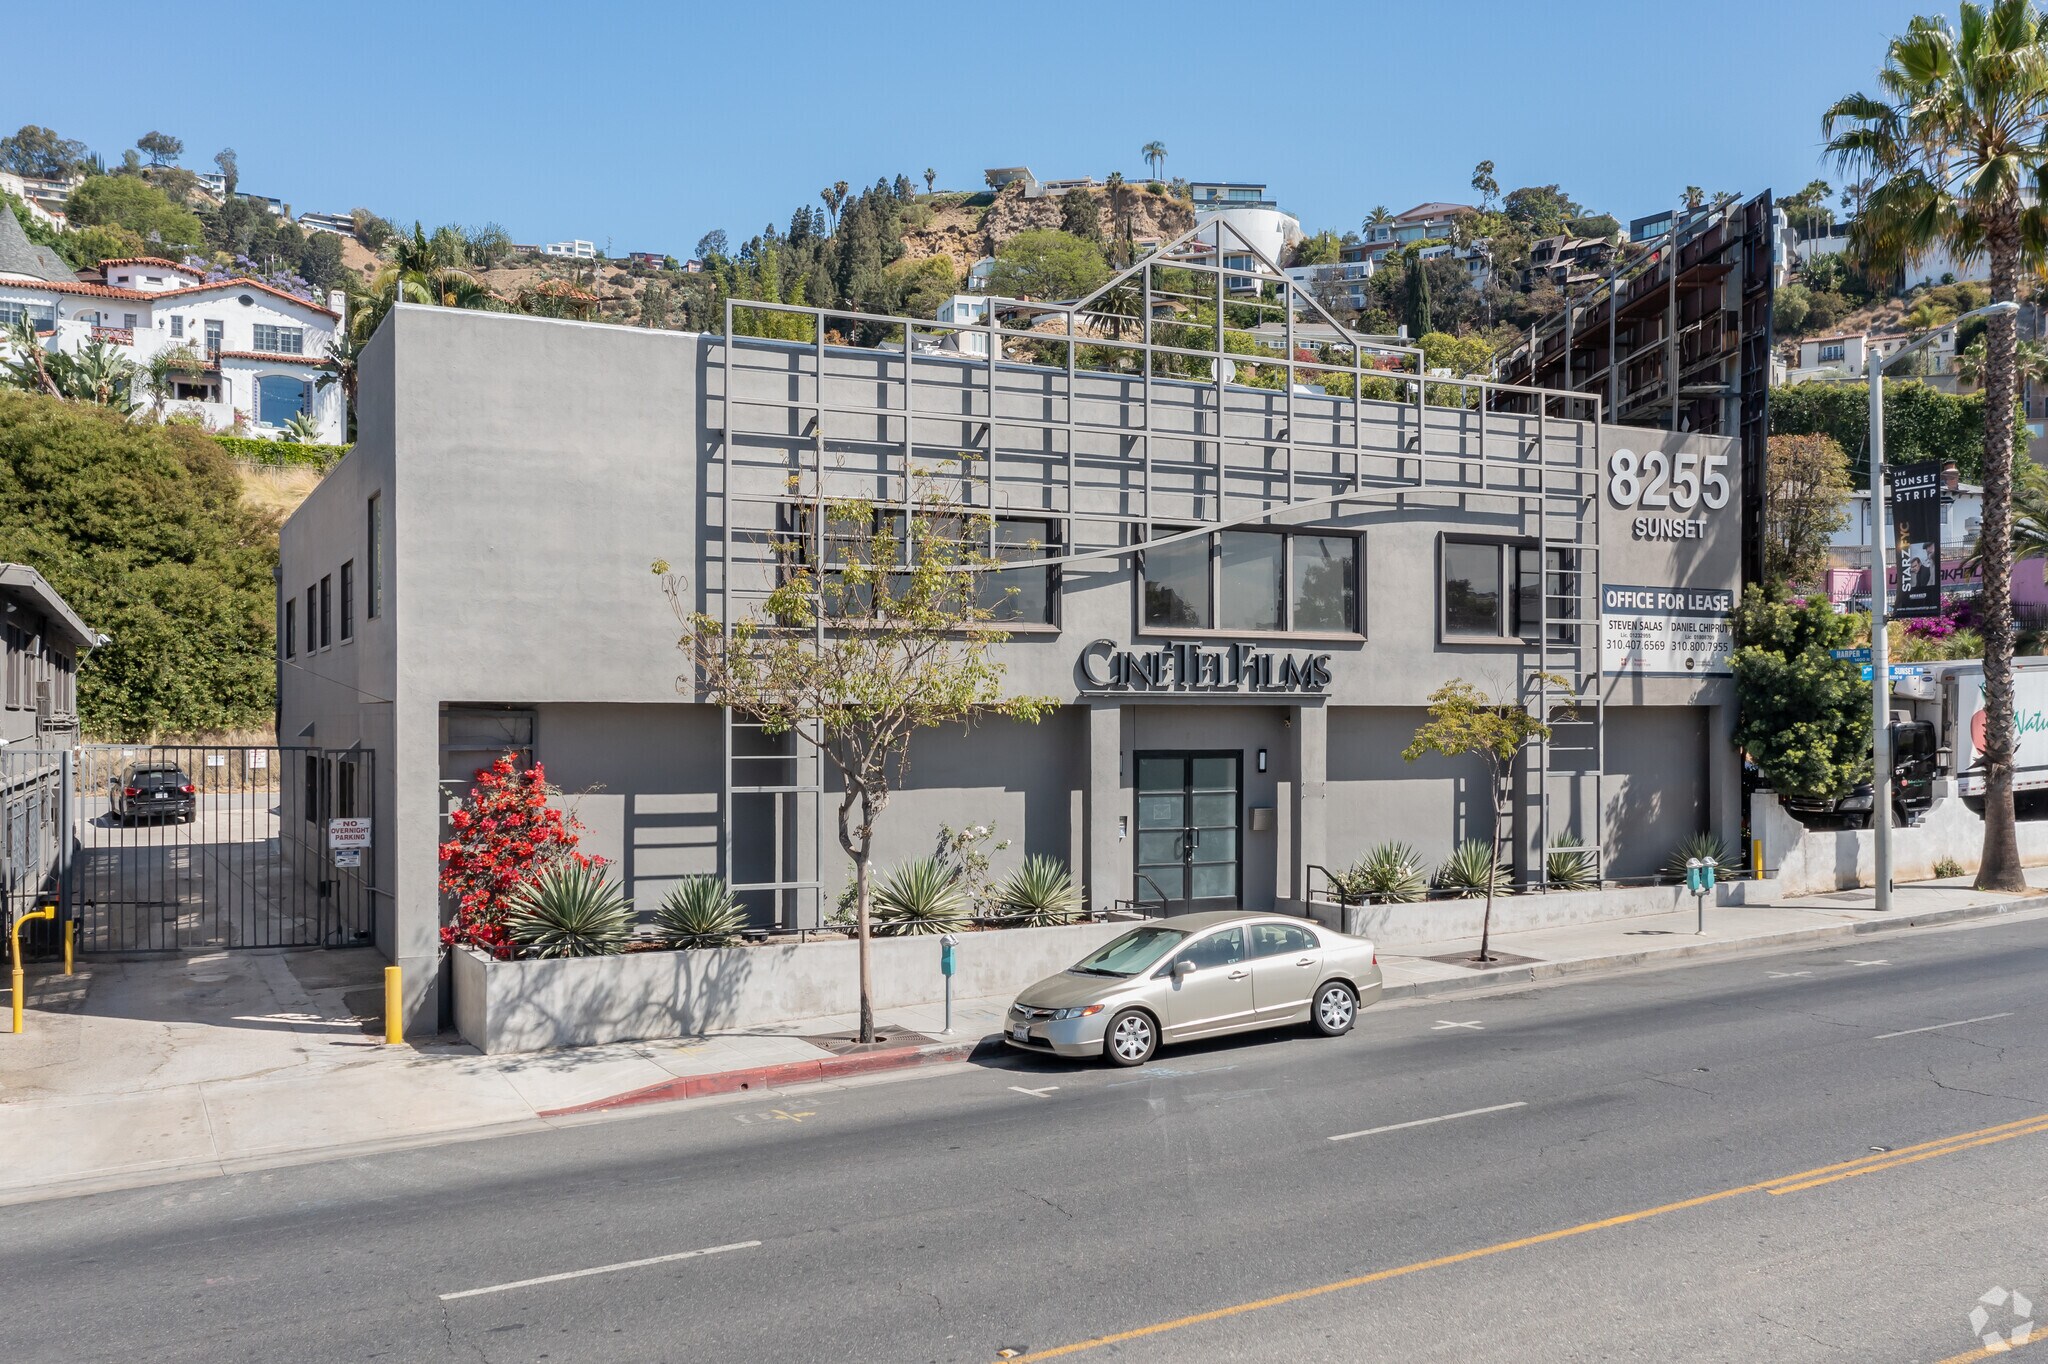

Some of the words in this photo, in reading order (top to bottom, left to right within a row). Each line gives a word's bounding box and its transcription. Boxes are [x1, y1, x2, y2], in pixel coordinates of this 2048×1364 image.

[1611, 449, 1730, 509] 8255
[1895, 474, 1936, 487] SUNSET
[1896, 489, 1936, 502] STRIP
[1634, 517, 1707, 538] SUNSET
[1900, 521, 1910, 548] FYC
[1902, 549, 1912, 592] STARZ
[1606, 590, 1654, 609] OFFICE
[1658, 593, 1684, 610] FOR
[1688, 594, 1729, 611] LEASE
[1609, 620, 1637, 631] STEVEN
[1640, 621, 1663, 631] SALAS
[1671, 622, 1697, 632] DANIEL
[1699, 623, 1729, 633] CHIPRUT
[1606, 639, 1665, 651] 310.407.6569
[1671, 641, 1729, 652] 310.800.7955
[1836, 650, 1860, 659] HARPER
[1894, 667, 1914, 675] SUNSET
